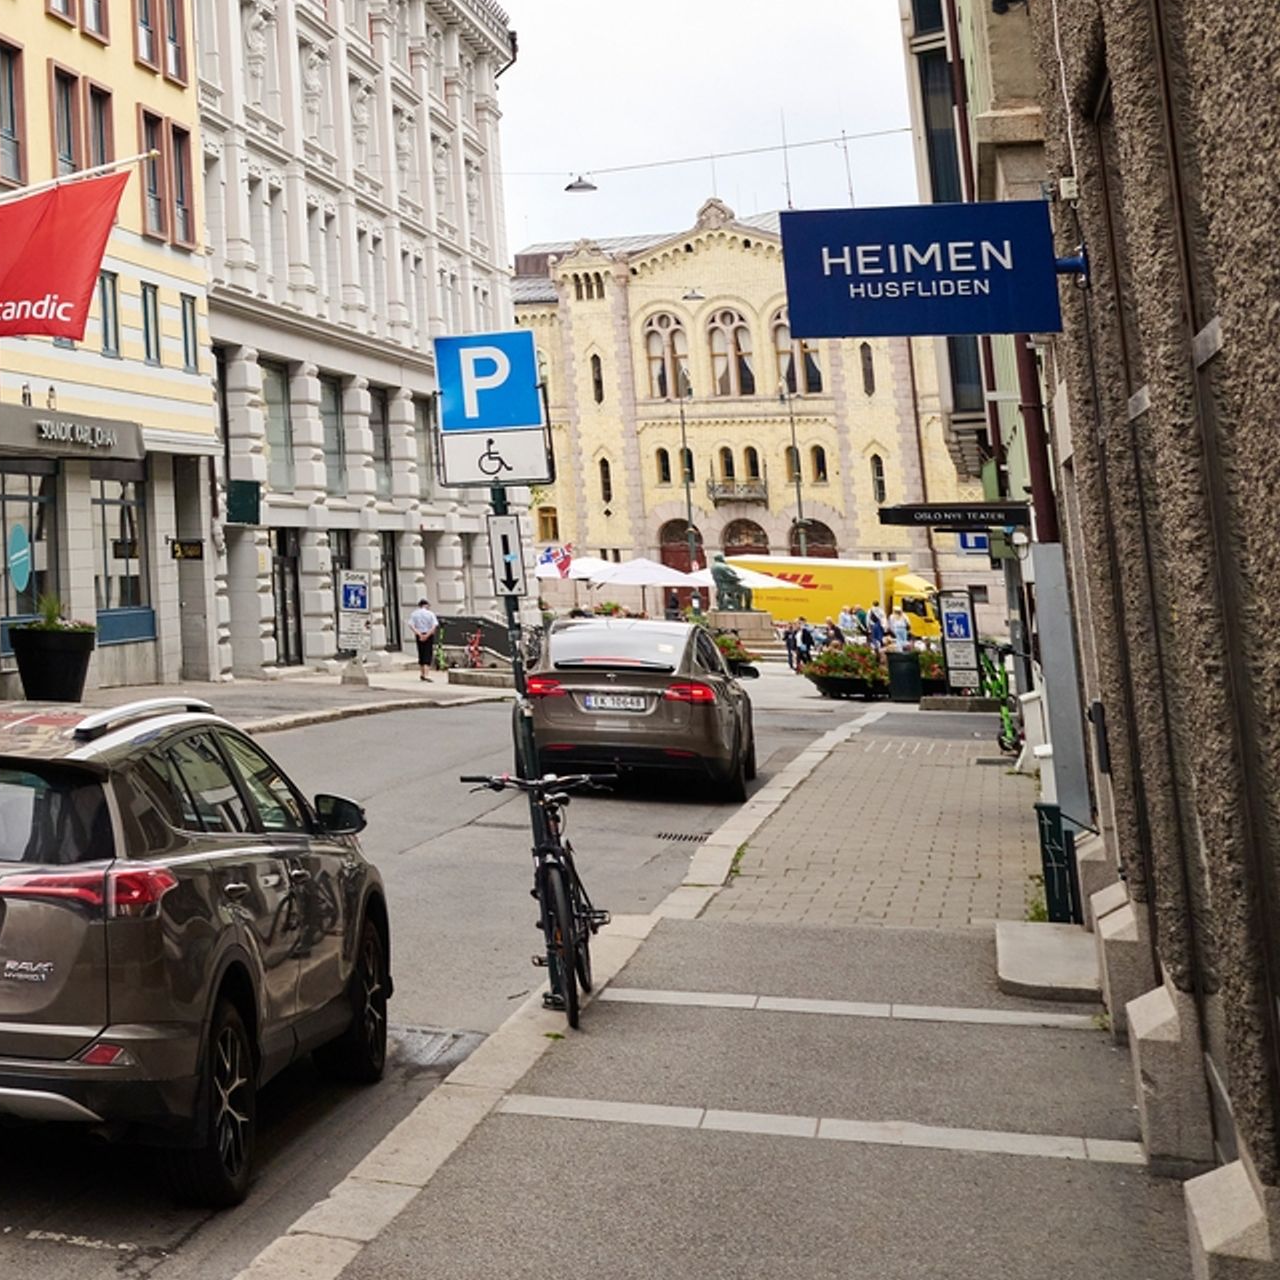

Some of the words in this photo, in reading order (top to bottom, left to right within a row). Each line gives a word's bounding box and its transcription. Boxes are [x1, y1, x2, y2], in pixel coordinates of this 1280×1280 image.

[822, 240, 1013, 276] HEIMEN
[849, 279, 990, 299] HUSFLIDEN
[459, 346, 511, 419] P
[762, 572, 819, 589] HL
